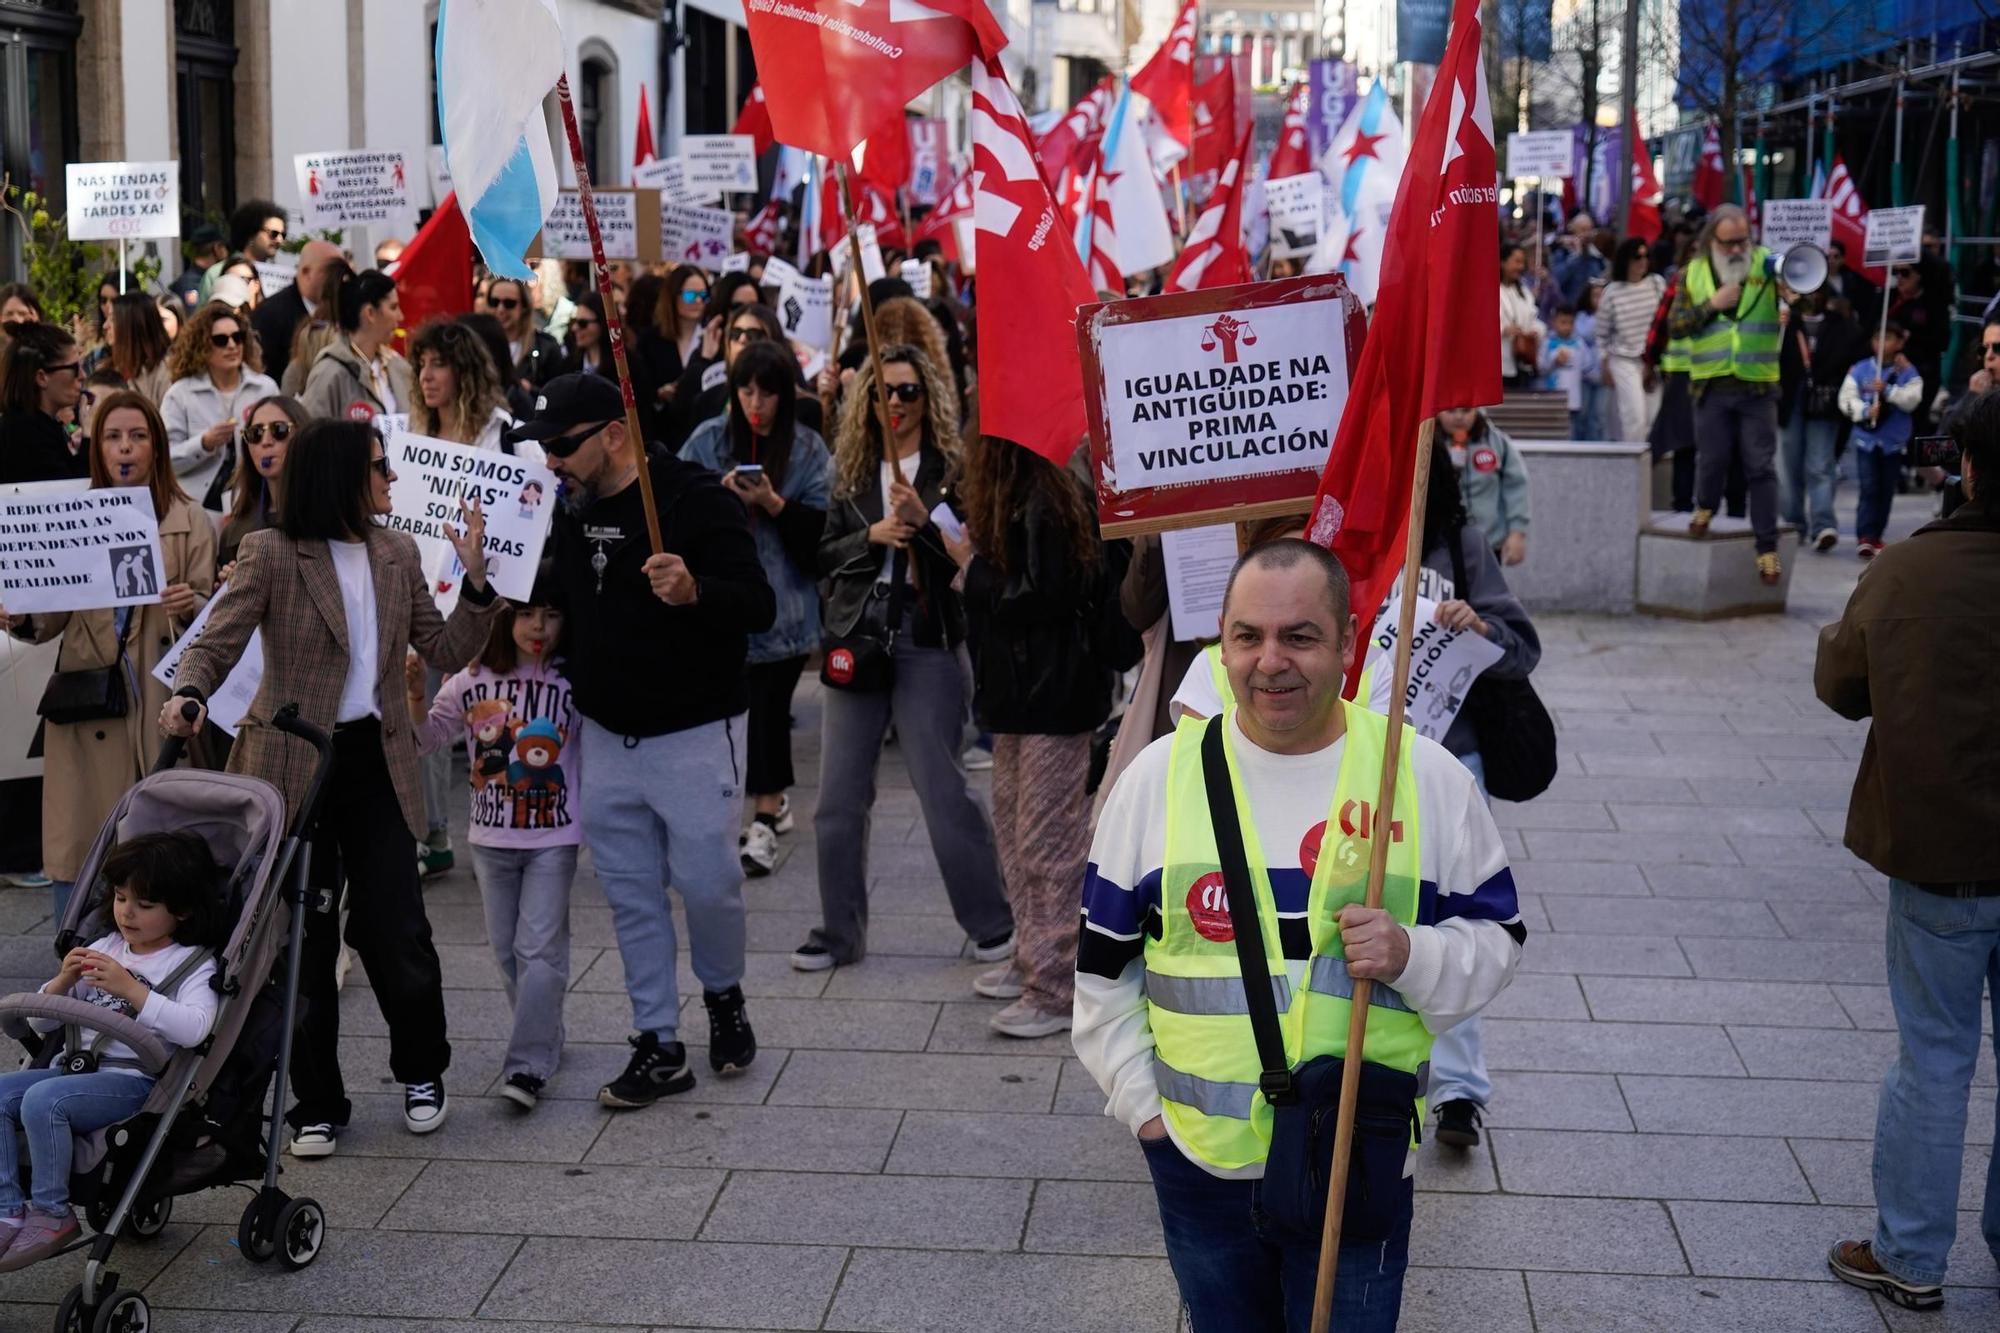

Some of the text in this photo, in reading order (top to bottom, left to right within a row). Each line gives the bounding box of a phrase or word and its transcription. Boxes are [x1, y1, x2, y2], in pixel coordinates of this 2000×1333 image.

[77, 172, 167, 187] NAS TENDAS
[326, 169, 340, 178] DE
[94, 189, 151, 201] PLUS DE
[83, 204, 136, 218] TARDES
[315, 203, 343, 213] NON
[609, 221, 633, 230] BEN
[1125, 355, 1331, 399] IGUALDADE NA
[1132, 380, 1328, 423] ANTIGÜIDADE:
[1188, 411, 1277, 440] PRIMA
[1138, 427, 1329, 471] VINCULACIÓN
[402, 445, 526, 486] NON SOMOS
[422, 474, 509, 506] "NIÑAS"
[6, 495, 133, 517] REDUCCIÓN POR
[425, 501, 489, 528] SOMS
[45, 518, 89, 533] PARA
[93, 515, 113, 528] AS
[114, 529, 148, 543] NON
[13, 558, 56, 570] UNHA
[3, 573, 93, 589] REALIDADE
